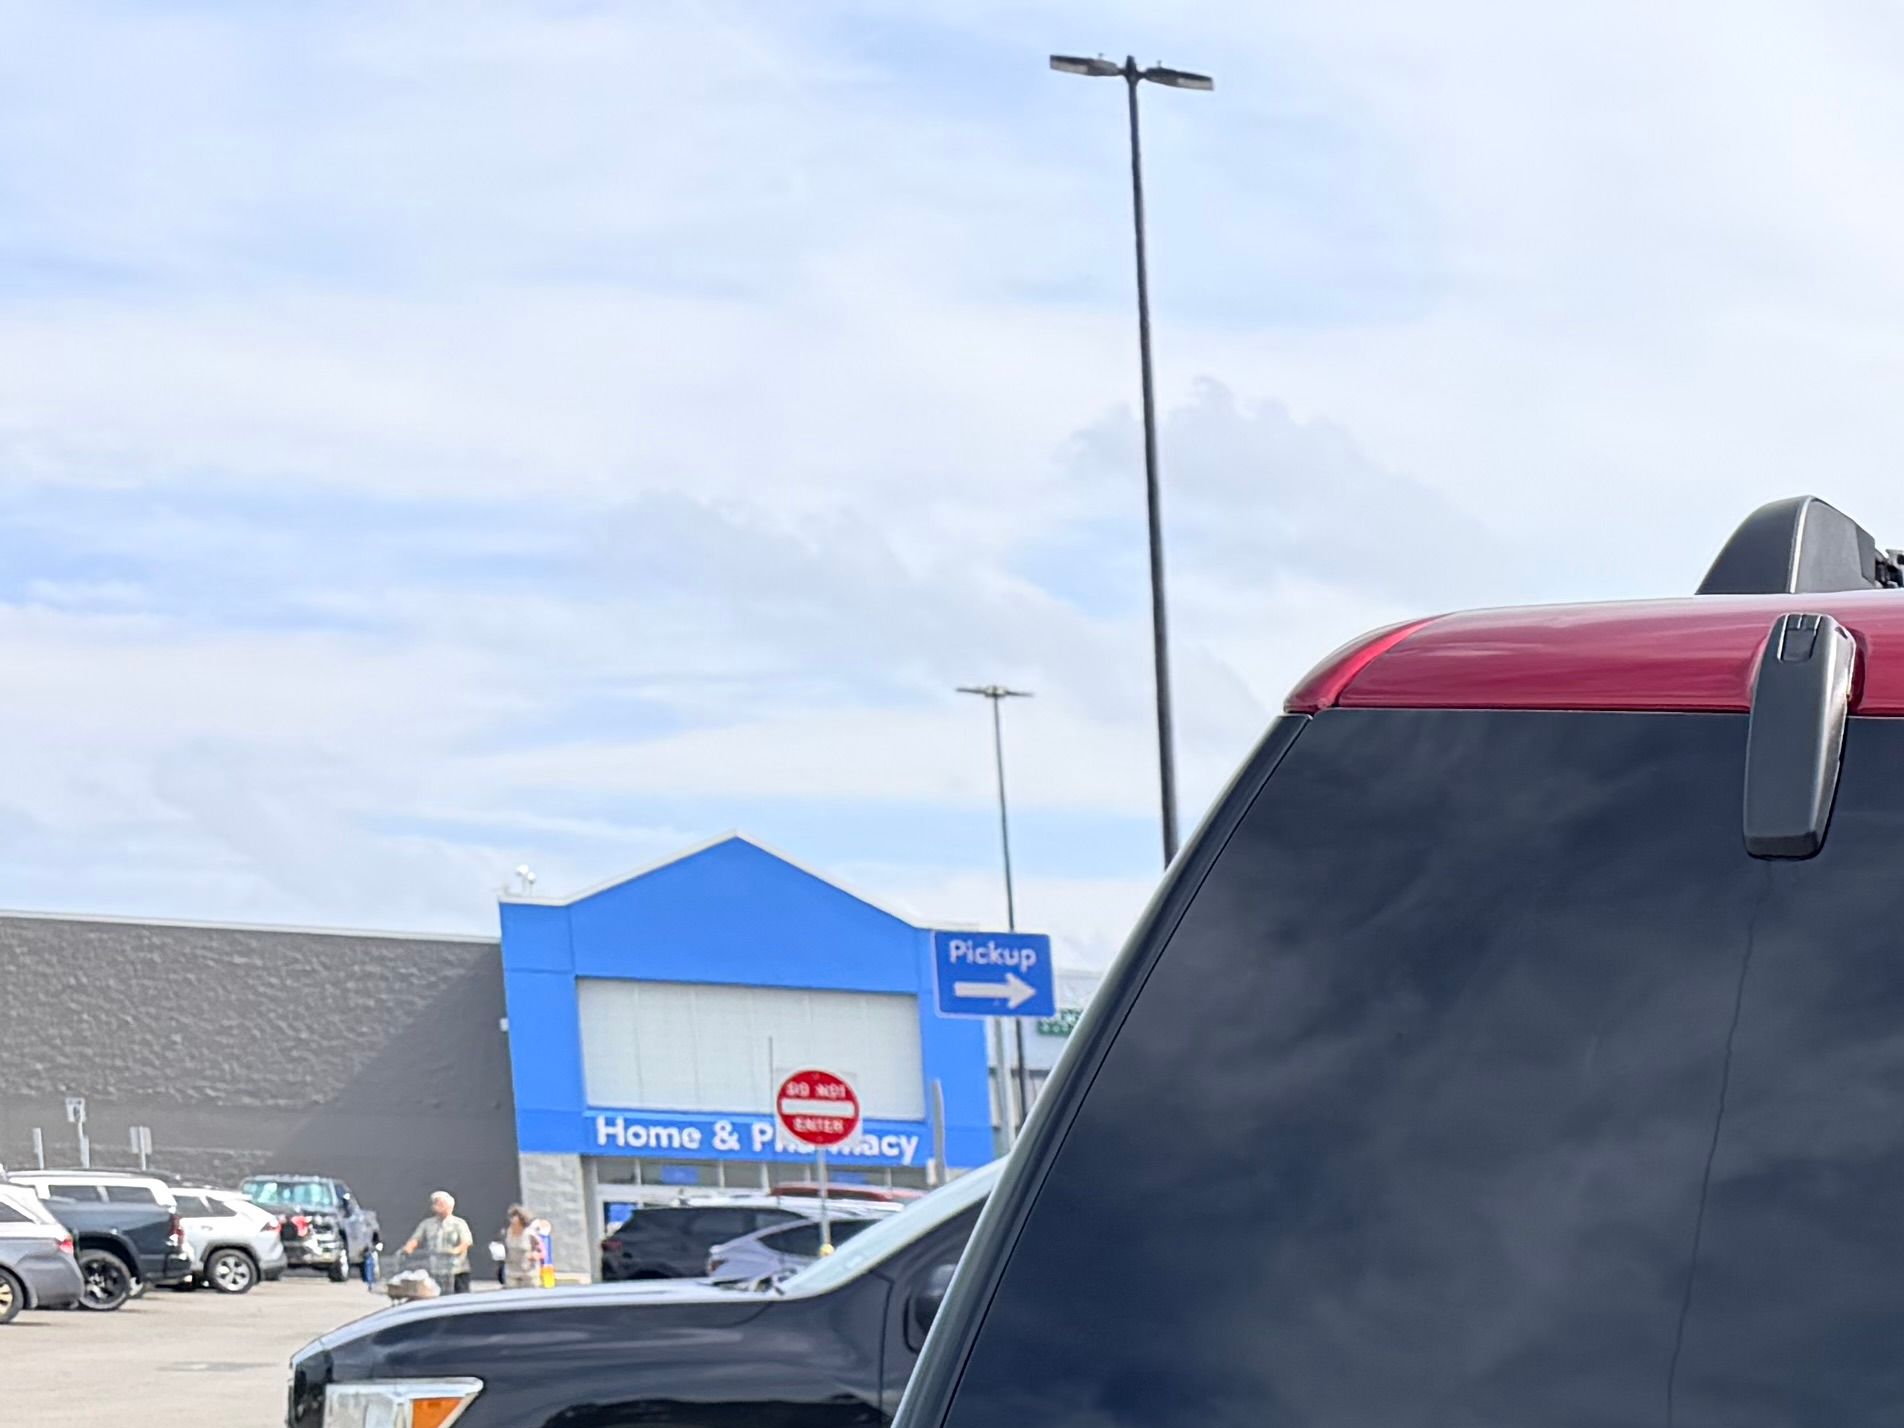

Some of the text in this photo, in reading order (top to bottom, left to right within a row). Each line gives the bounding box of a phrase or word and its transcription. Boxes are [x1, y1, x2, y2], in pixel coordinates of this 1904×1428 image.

[949, 939, 1037, 972] Pickup
[785, 1081, 810, 1097] DO
[793, 1117, 845, 1135] ENTER
[596, 1115, 919, 1167] Home & Pacy
